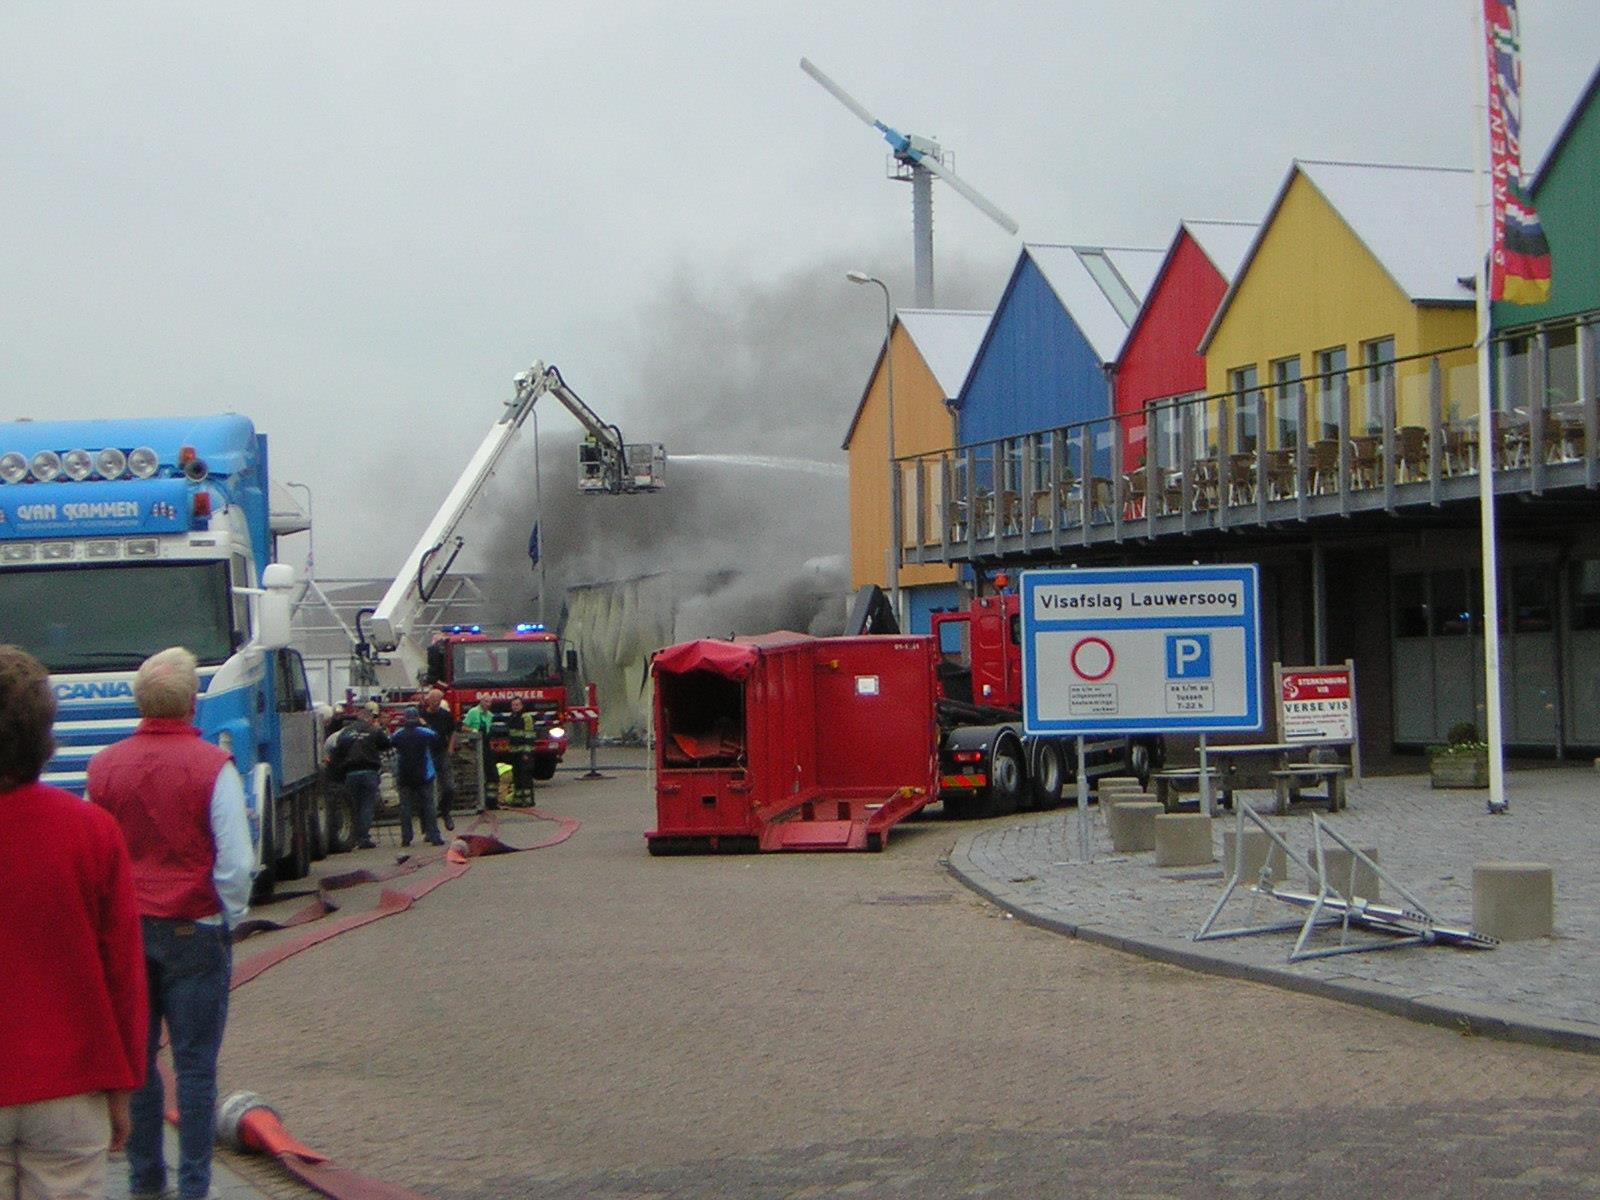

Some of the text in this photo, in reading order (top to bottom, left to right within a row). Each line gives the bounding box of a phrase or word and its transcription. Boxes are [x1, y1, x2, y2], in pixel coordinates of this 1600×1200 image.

[1041, 592, 1238, 611] Visafslag Lauwersoog
[1176, 639, 1202, 675] P
[54, 682, 135, 700] CANIA
[1285, 700, 1349, 712] VERSE VIS
